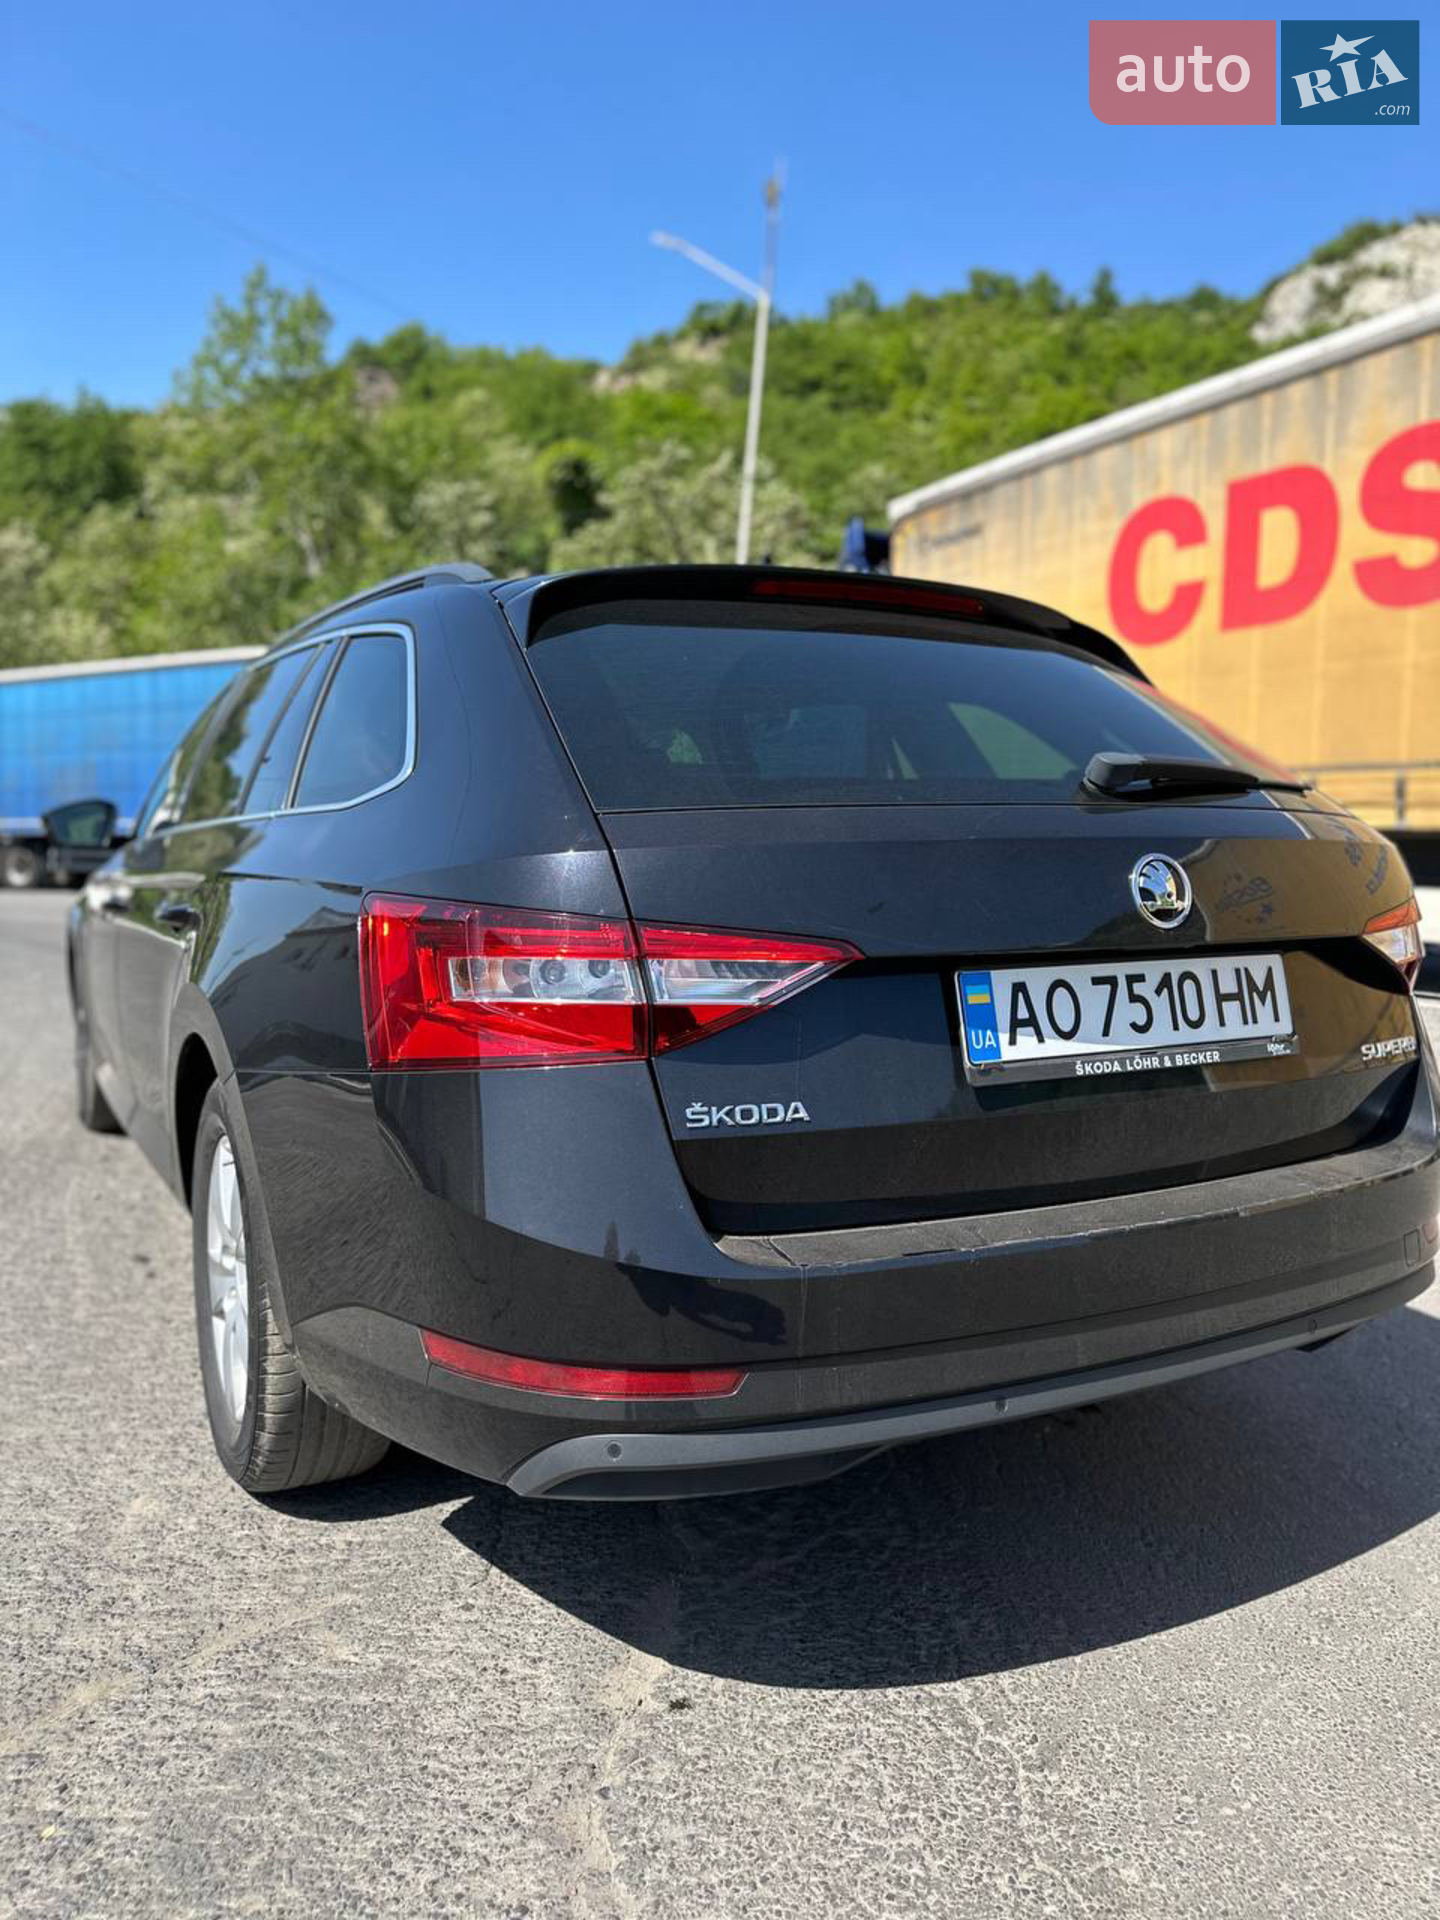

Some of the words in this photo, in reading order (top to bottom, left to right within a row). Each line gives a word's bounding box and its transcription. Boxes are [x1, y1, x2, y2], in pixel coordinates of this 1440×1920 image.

[1107, 419, 1440, 648] CDS
[1008, 978, 1082, 1047] AO
[1091, 970, 1206, 1038] 7510
[1211, 965, 1281, 1028] HM
[971, 1029, 998, 1050] UA
[1075, 1059, 1123, 1077] ŠKODA
[1163, 1055, 1173, 1068] &
[1175, 1051, 1221, 1066] BECKER
[685, 1101, 812, 1128] ŠKODA
